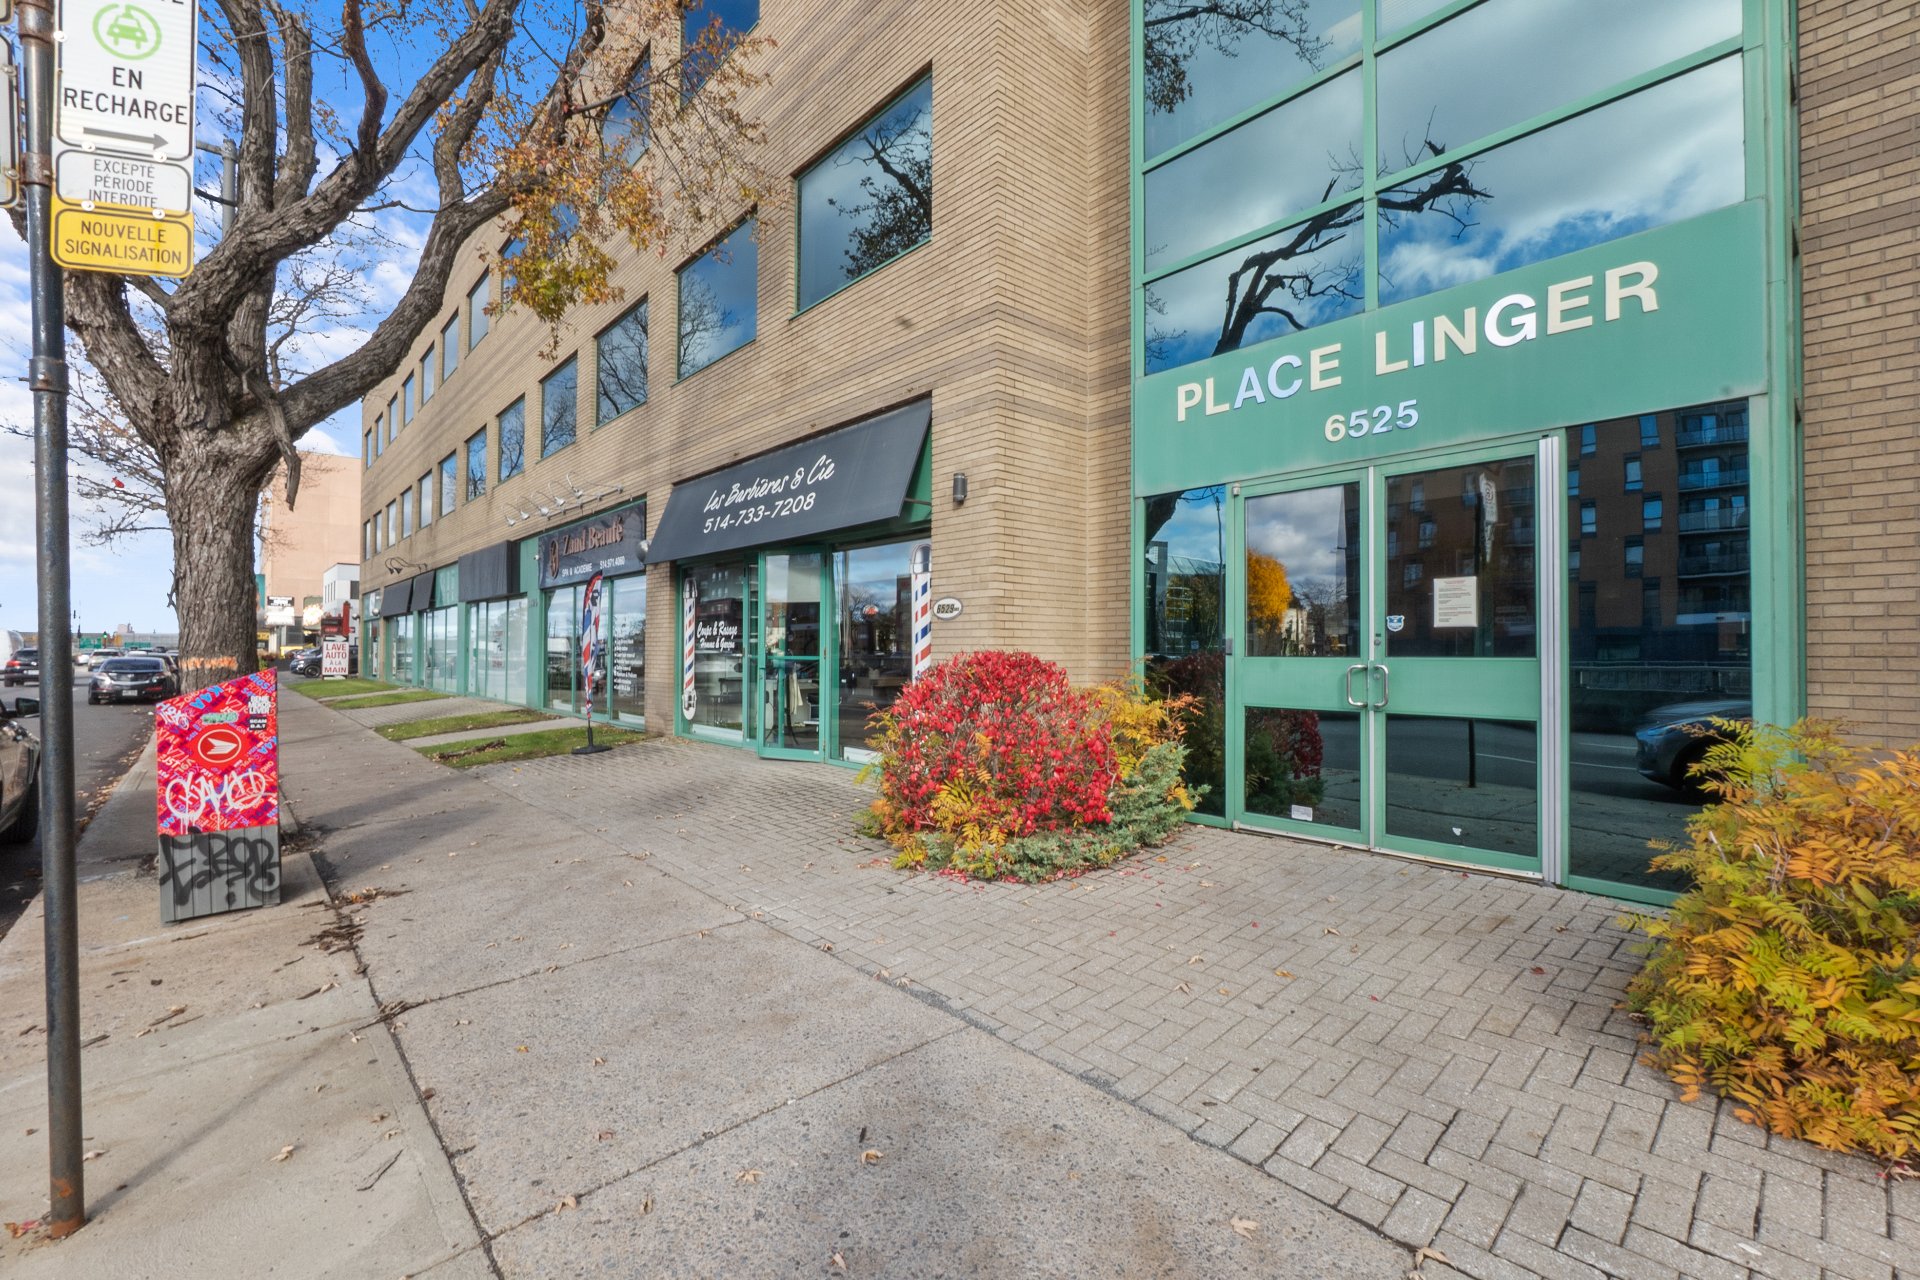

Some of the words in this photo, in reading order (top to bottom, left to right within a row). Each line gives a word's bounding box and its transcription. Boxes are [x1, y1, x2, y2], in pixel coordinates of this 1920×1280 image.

[112, 66, 143, 90] EN
[63, 87, 188, 125] RECHARGE
[94, 174, 154, 194] PÉRIODE
[88, 188, 158, 209] INTERDITE
[81, 220, 167, 244] NOUVELLE
[65, 239, 182, 265] SIGNALISATION
[1176, 342, 1342, 422] PLACE
[1375, 260, 1660, 376] LINGER
[1324, 398, 1420, 443] 6525
[703, 490, 725, 514] Les
[790, 467, 805, 490] &
[807, 454, 836, 485] Cie
[703, 492, 817, 534] 514-733-7208
[937, 603, 955, 614] 6529
[325, 643, 347, 651] LAVE
[325, 651, 347, 659] AUTO
